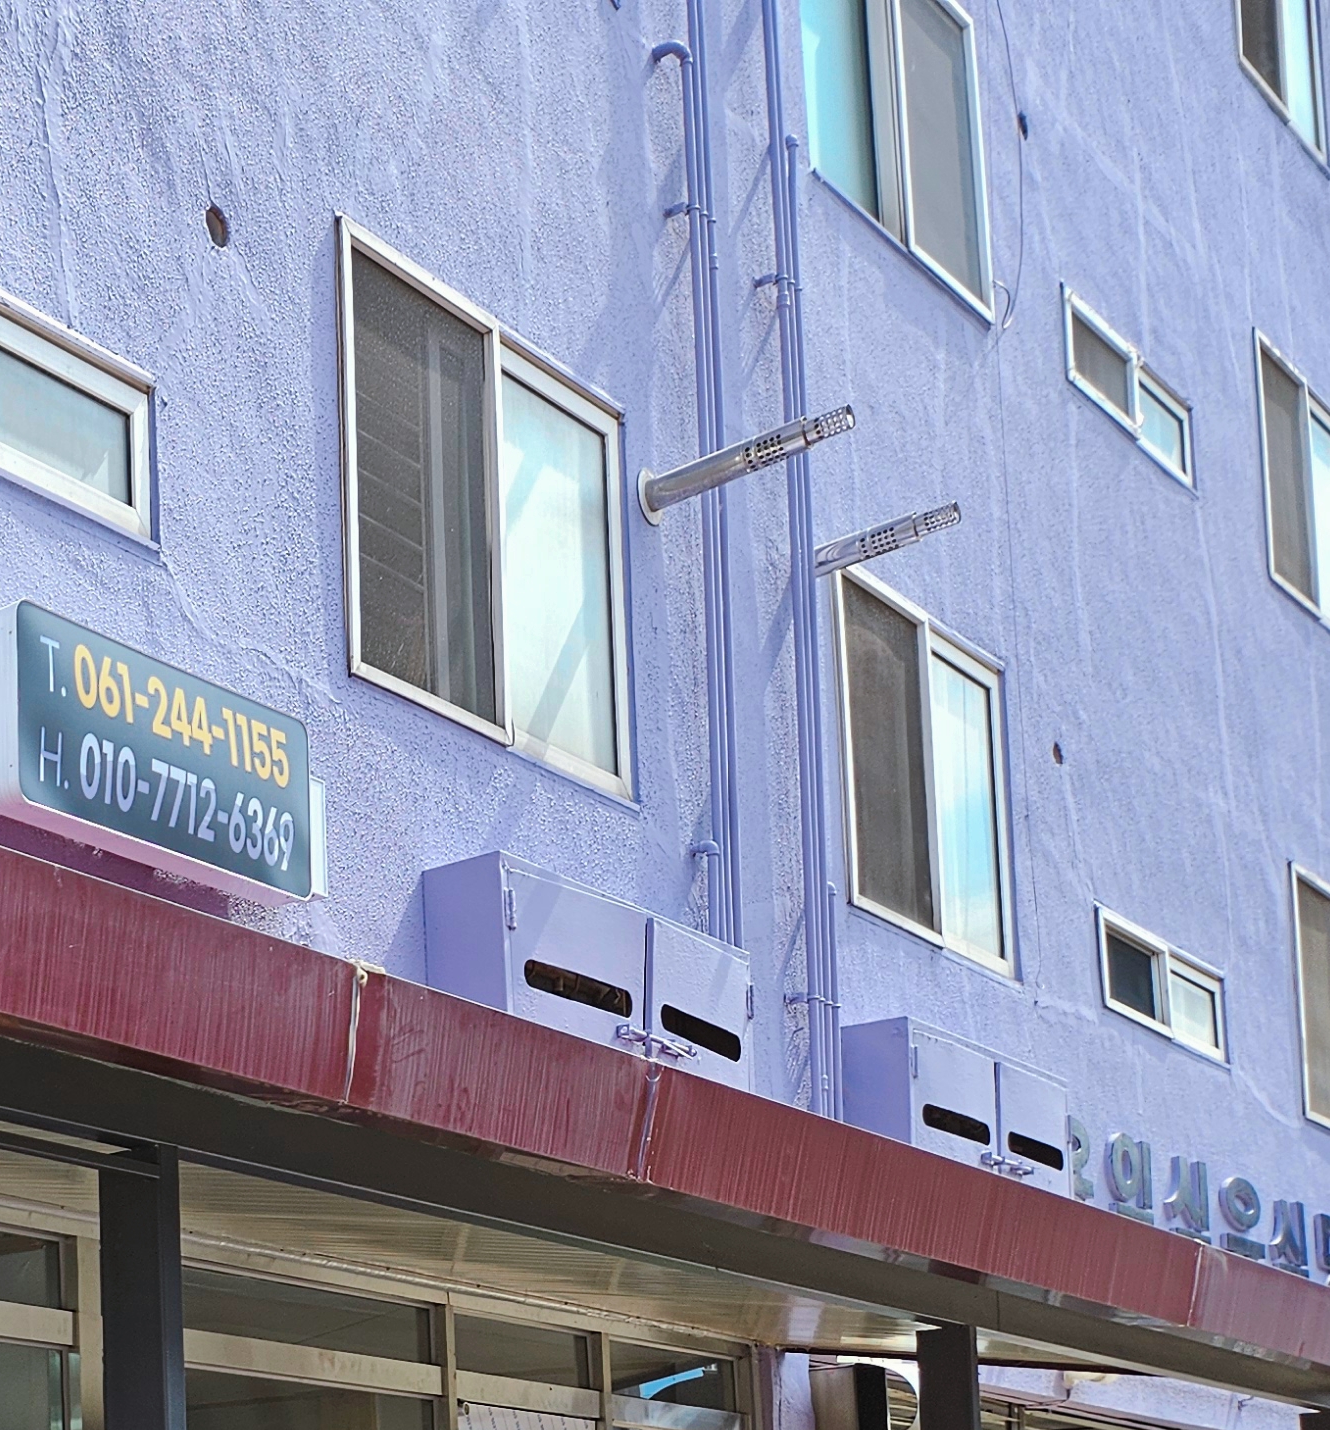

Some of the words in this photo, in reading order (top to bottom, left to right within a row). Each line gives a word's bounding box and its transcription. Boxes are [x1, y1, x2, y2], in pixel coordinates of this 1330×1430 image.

[39, 635, 67, 697] T.
[73, 643, 290, 789] 061-244-1155
[39, 726, 69, 790] H.
[79, 732, 295, 872] 010-7712-6369
